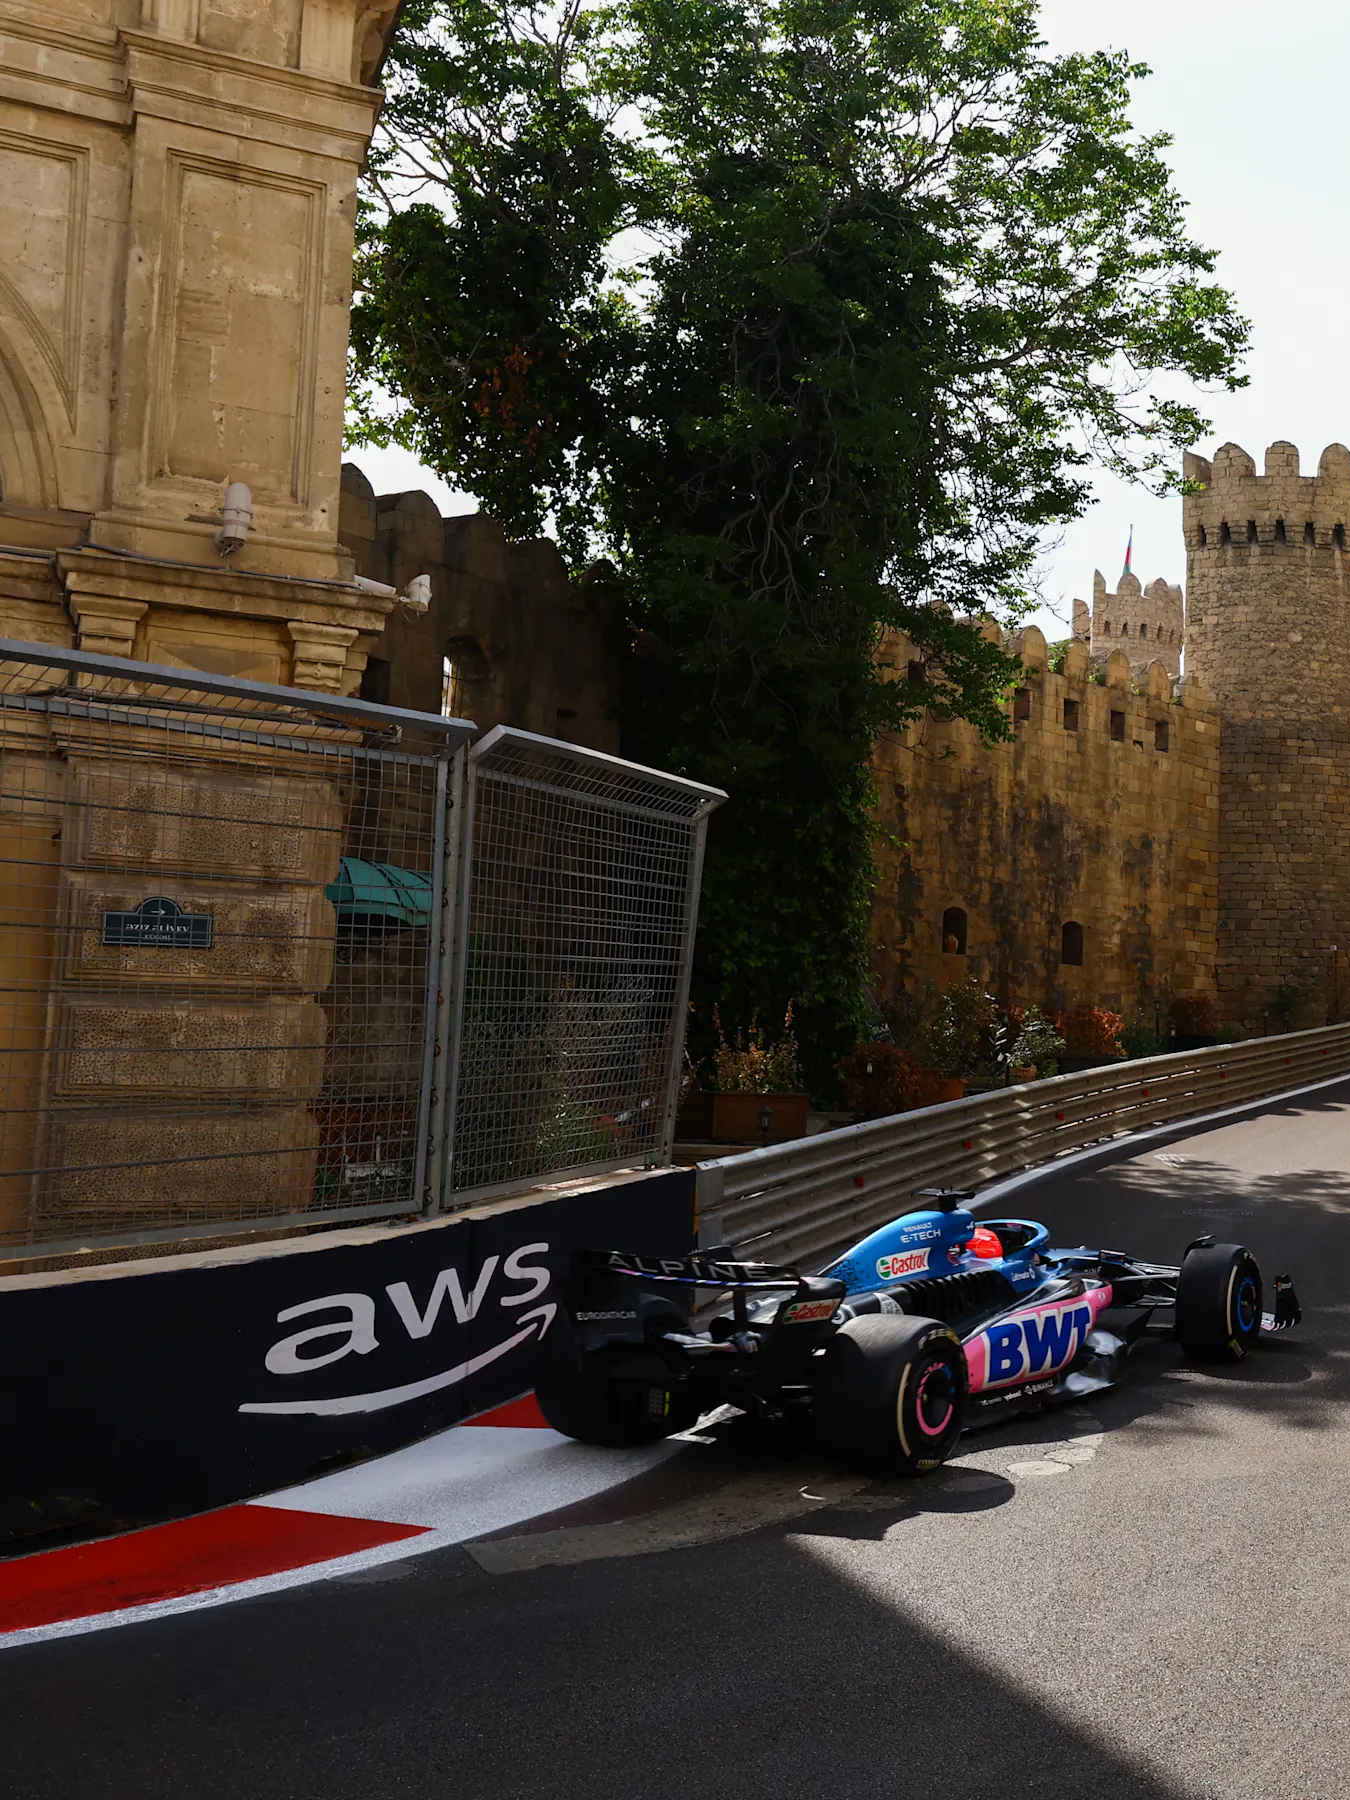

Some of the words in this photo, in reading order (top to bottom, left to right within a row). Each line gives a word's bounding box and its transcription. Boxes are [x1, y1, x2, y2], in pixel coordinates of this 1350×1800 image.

[900, 1229, 941, 1244] E-TECH
[903, 1221, 932, 1233] RENAULT
[607, 1253, 772, 1280] ALPINE
[891, 1251, 928, 1275] Castrol
[265, 1243, 550, 1374] aws
[576, 1311, 637, 1321] EURODATACAR
[794, 1302, 835, 1320] Castrol
[988, 1305, 1091, 1383] BWT
